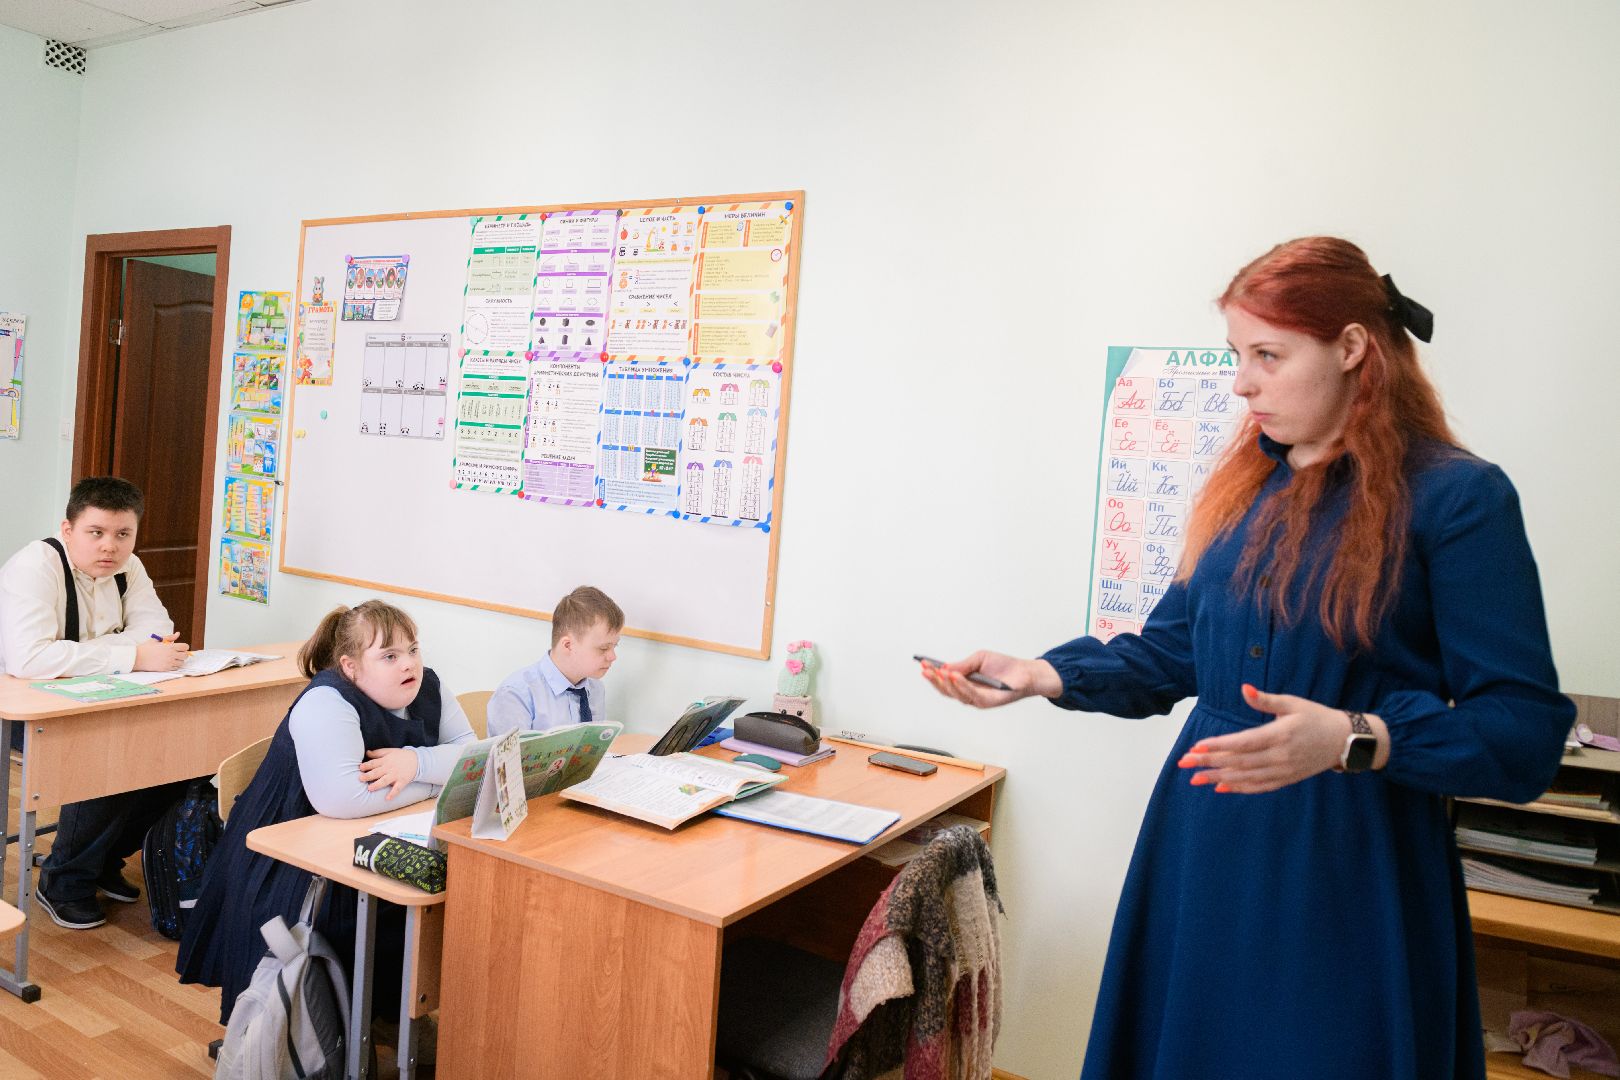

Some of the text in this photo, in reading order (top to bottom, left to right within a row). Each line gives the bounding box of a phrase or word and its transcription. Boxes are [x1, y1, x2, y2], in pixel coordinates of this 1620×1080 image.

[1118, 378, 1217, 390] Аа Бб Вв
[1114, 418, 1220, 432] Ее Ёё Жж
[1111, 458, 1127, 470] Йй
[1152, 462, 1168, 472] Кк
[1108, 499, 1164, 513] Оо Пп
[1106, 540, 1165, 555] Уу Фф
[1102, 580, 1122, 590] Шш
[1099, 620, 1113, 630] Ээ
